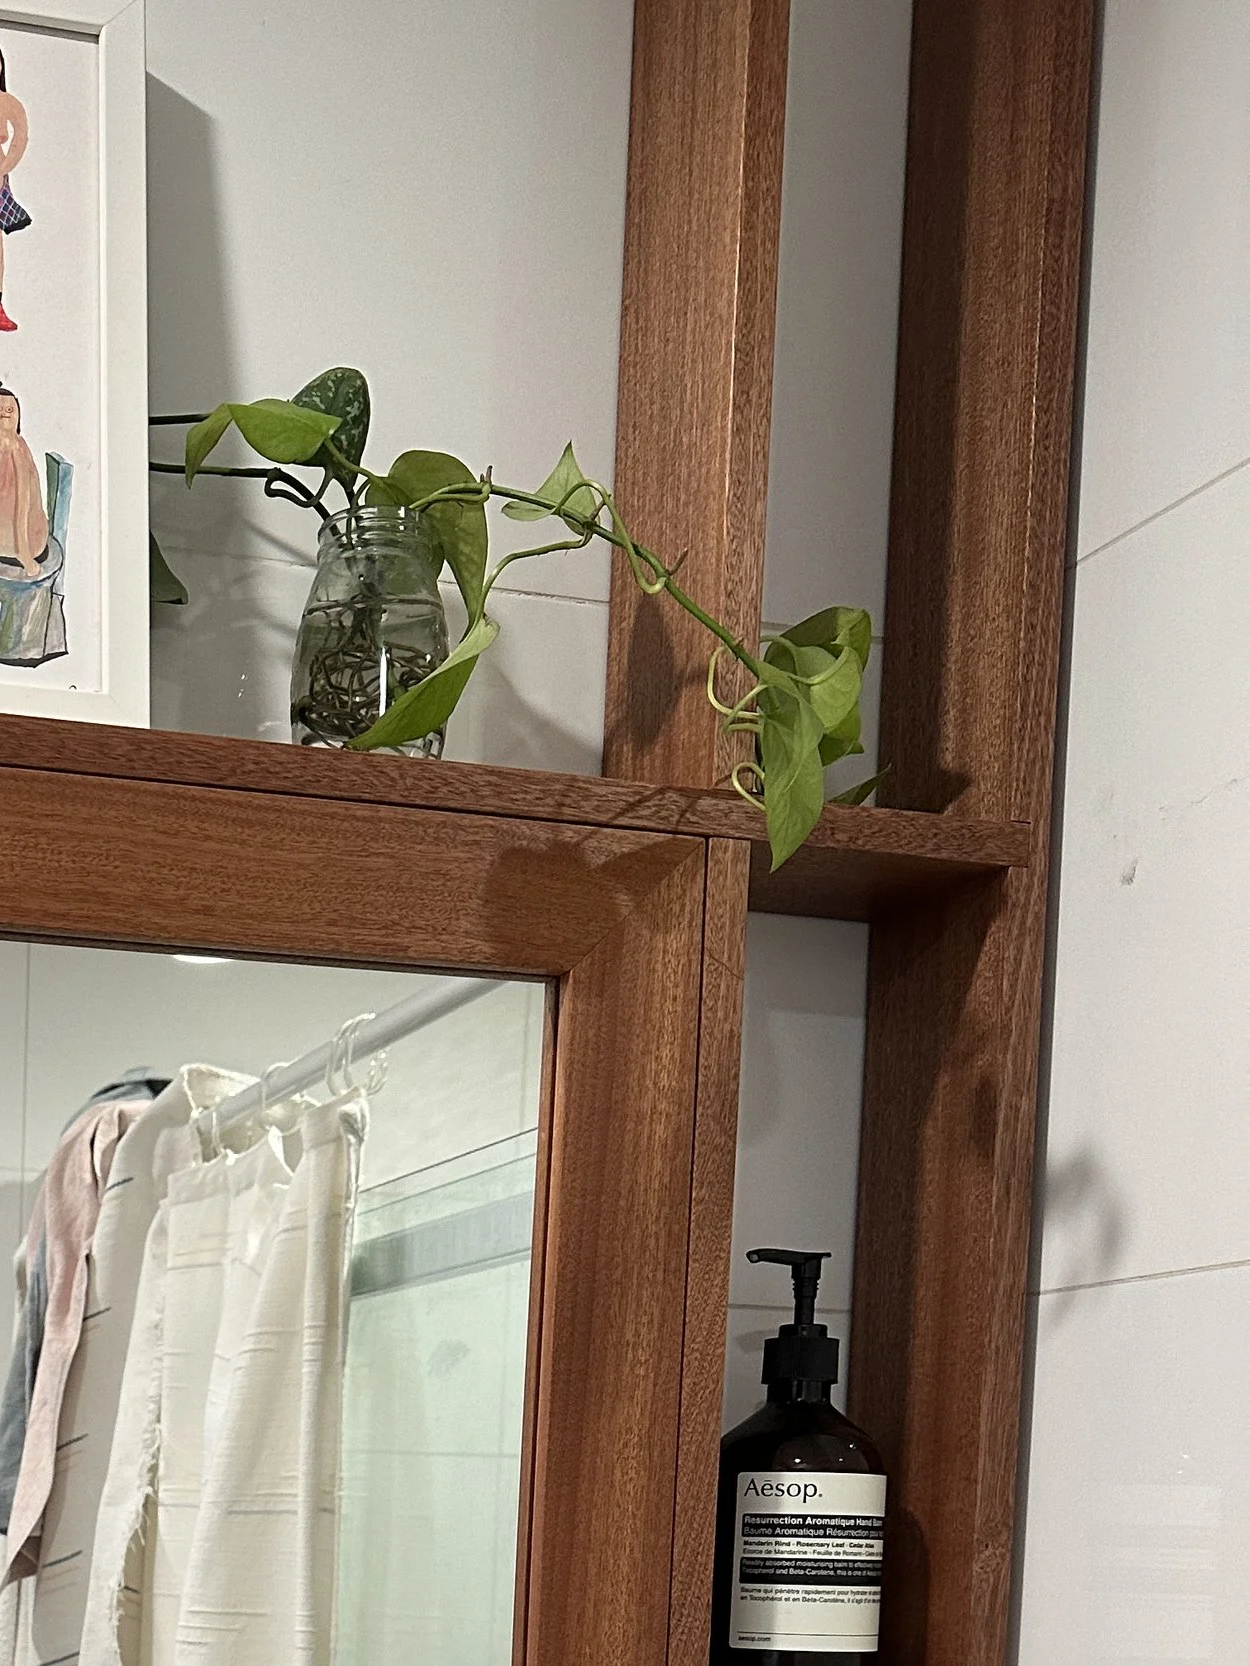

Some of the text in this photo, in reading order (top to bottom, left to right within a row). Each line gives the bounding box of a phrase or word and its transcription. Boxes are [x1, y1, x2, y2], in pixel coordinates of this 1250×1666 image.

[744, 1516, 803, 1525] Resurrection
[805, 1517, 855, 1527] Aromatique
[856, 1518, 872, 1526] Hand
[744, 1526, 772, 1535] Baume
[774, 1527, 824, 1537] Aromatique
[796, 1541, 830, 1549] Rosemary
